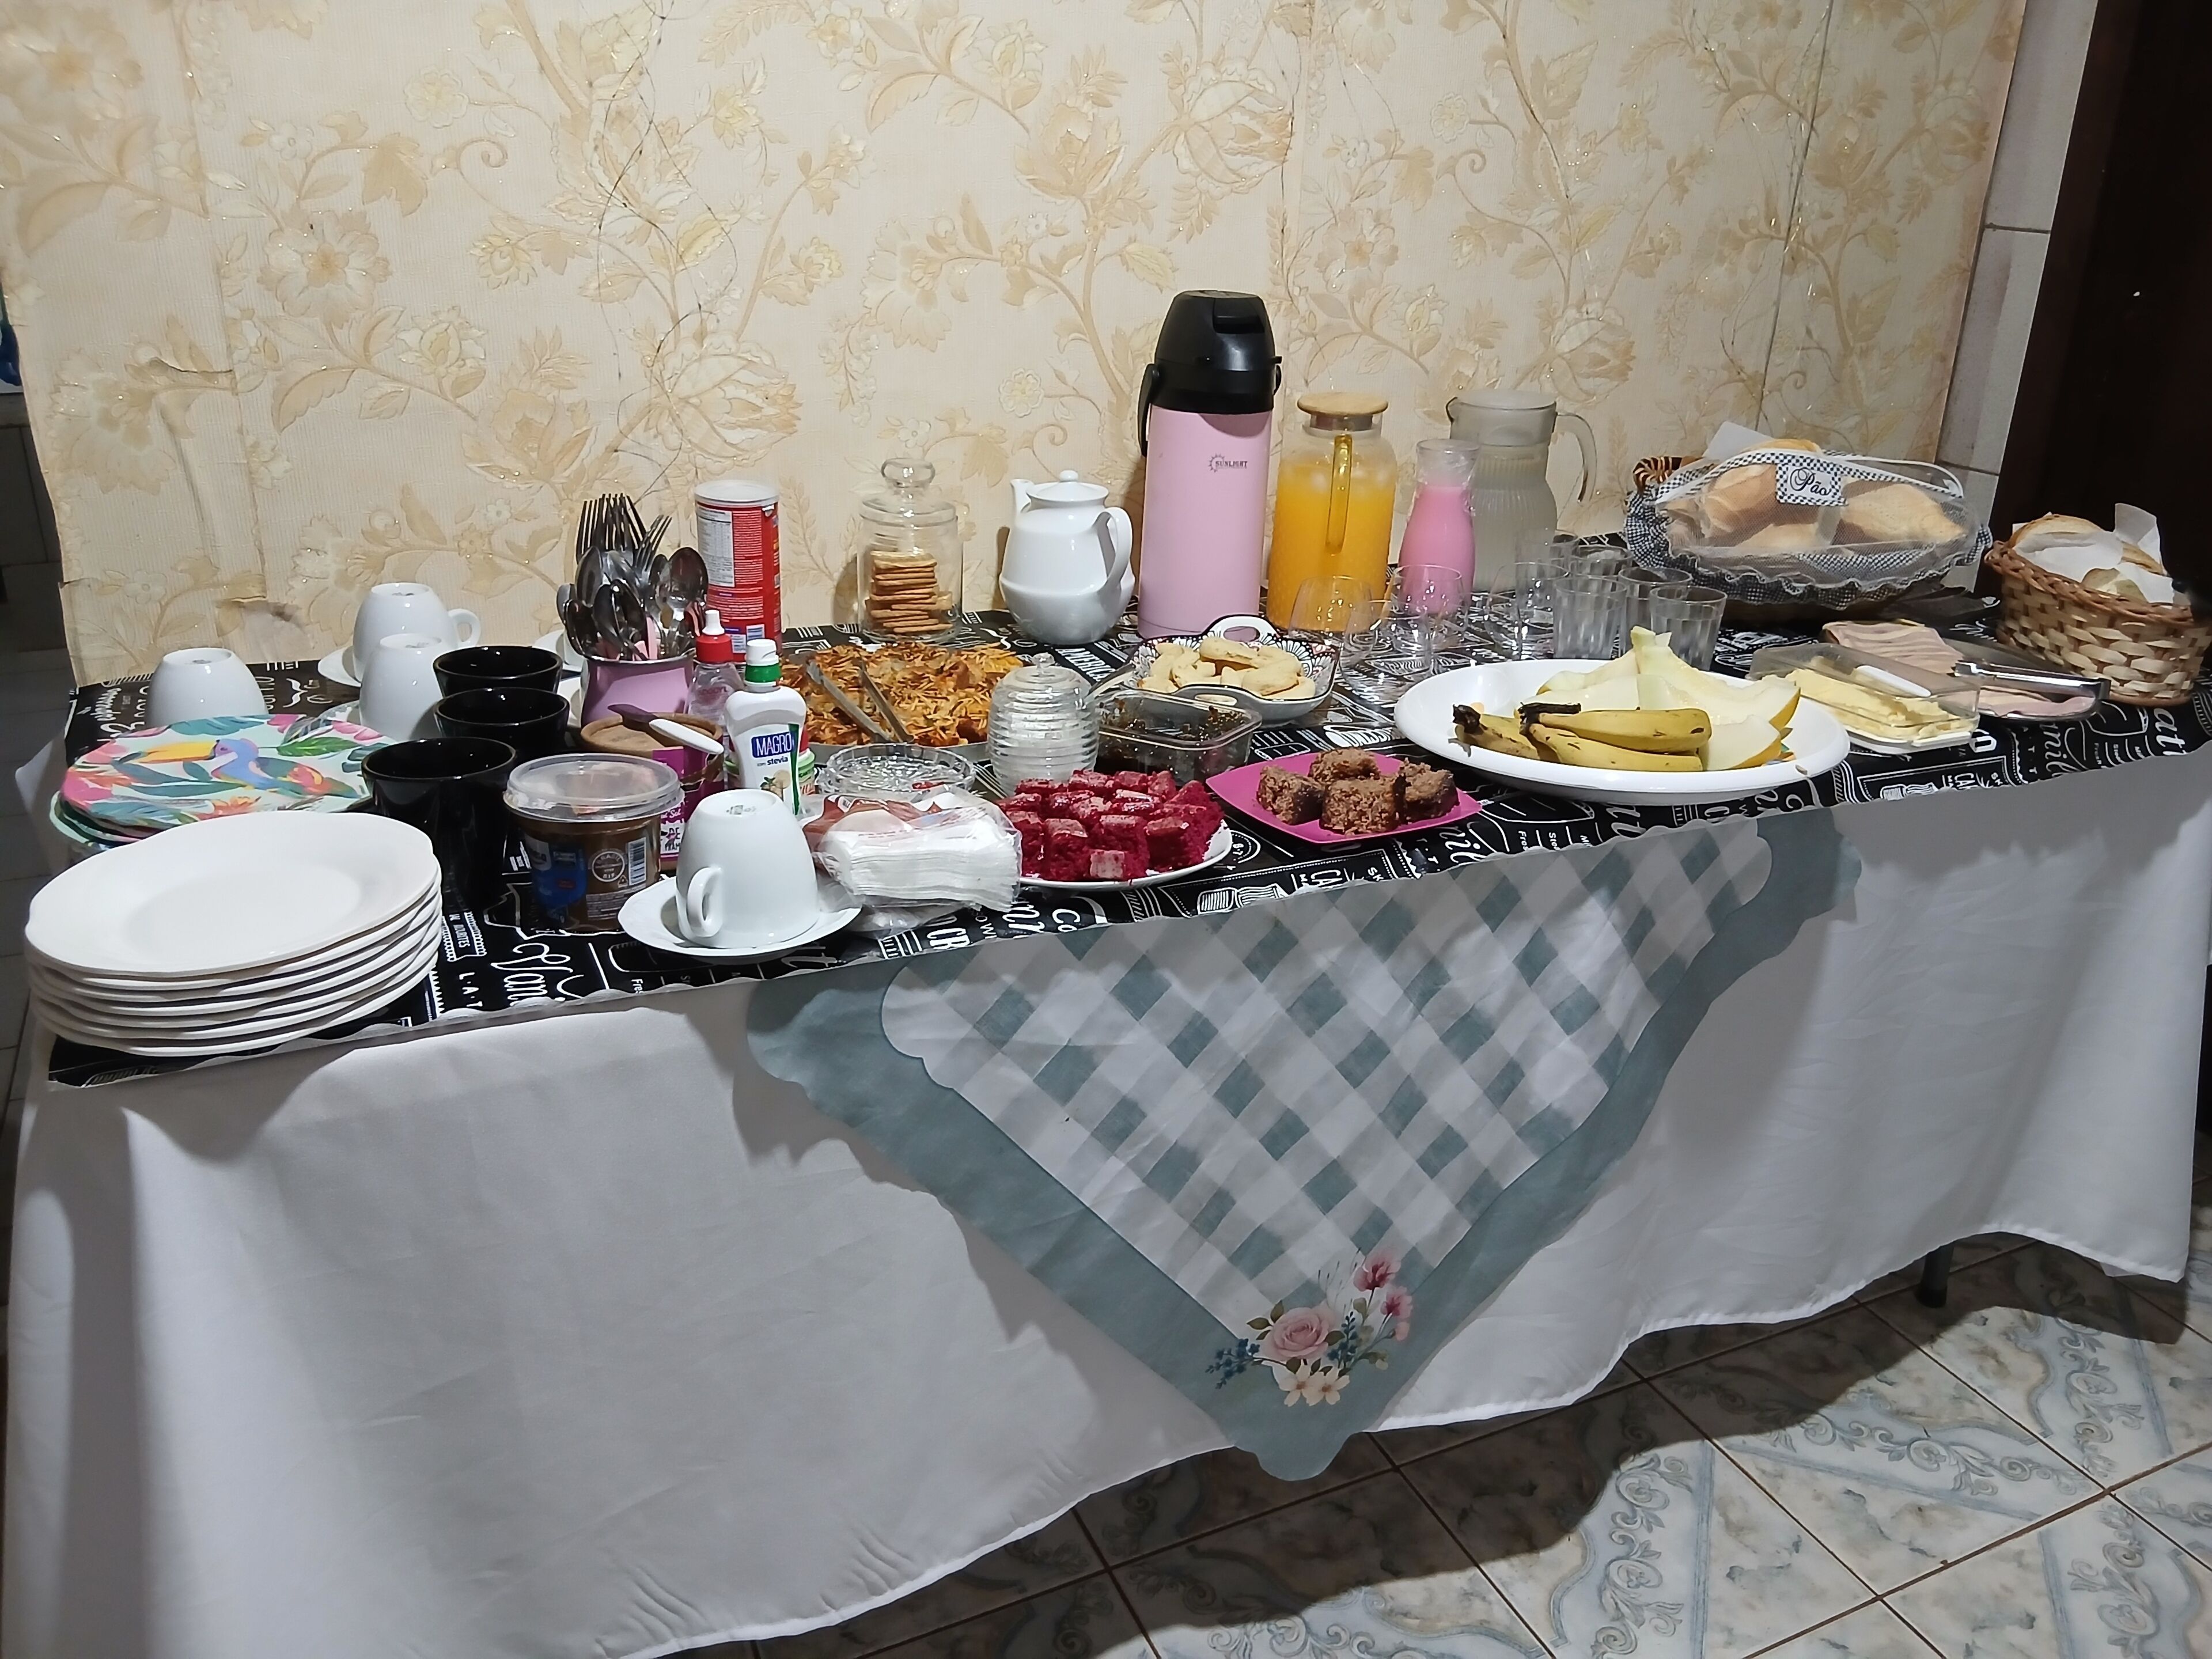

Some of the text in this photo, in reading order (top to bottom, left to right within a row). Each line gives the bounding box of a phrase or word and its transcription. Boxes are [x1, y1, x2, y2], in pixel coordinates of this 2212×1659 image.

[1215, 460, 1248, 469] SUNLIGHT
[1790, 467, 1832, 496] Pão
[756, 732, 793, 756] MAGRO
[767, 756, 789, 766] stevia
